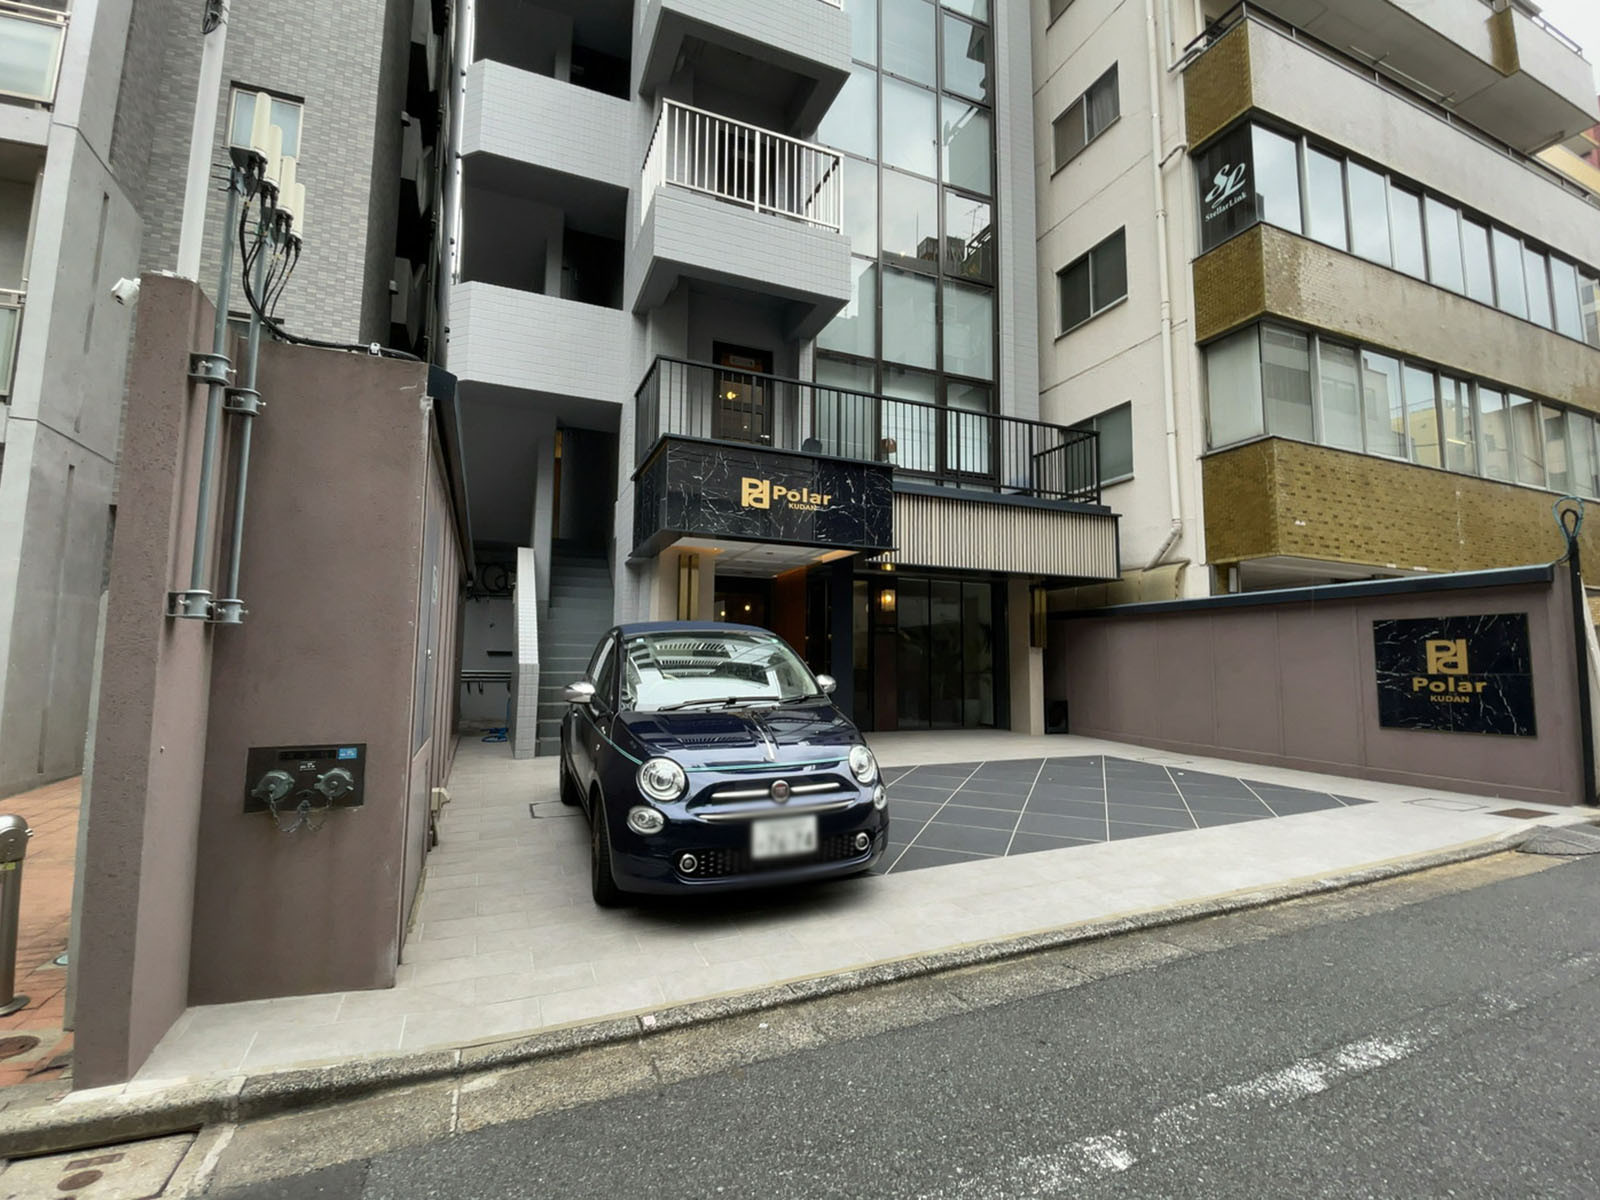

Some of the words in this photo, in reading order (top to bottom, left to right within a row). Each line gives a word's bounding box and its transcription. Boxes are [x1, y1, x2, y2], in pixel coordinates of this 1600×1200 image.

[1205, 192, 1247, 222] StellarLink
[773, 485, 832, 505] Polar
[788, 503, 817, 511] KUDAN
[1412, 677, 1487, 693] Polar
[1430, 695, 1470, 703] KUDAN
